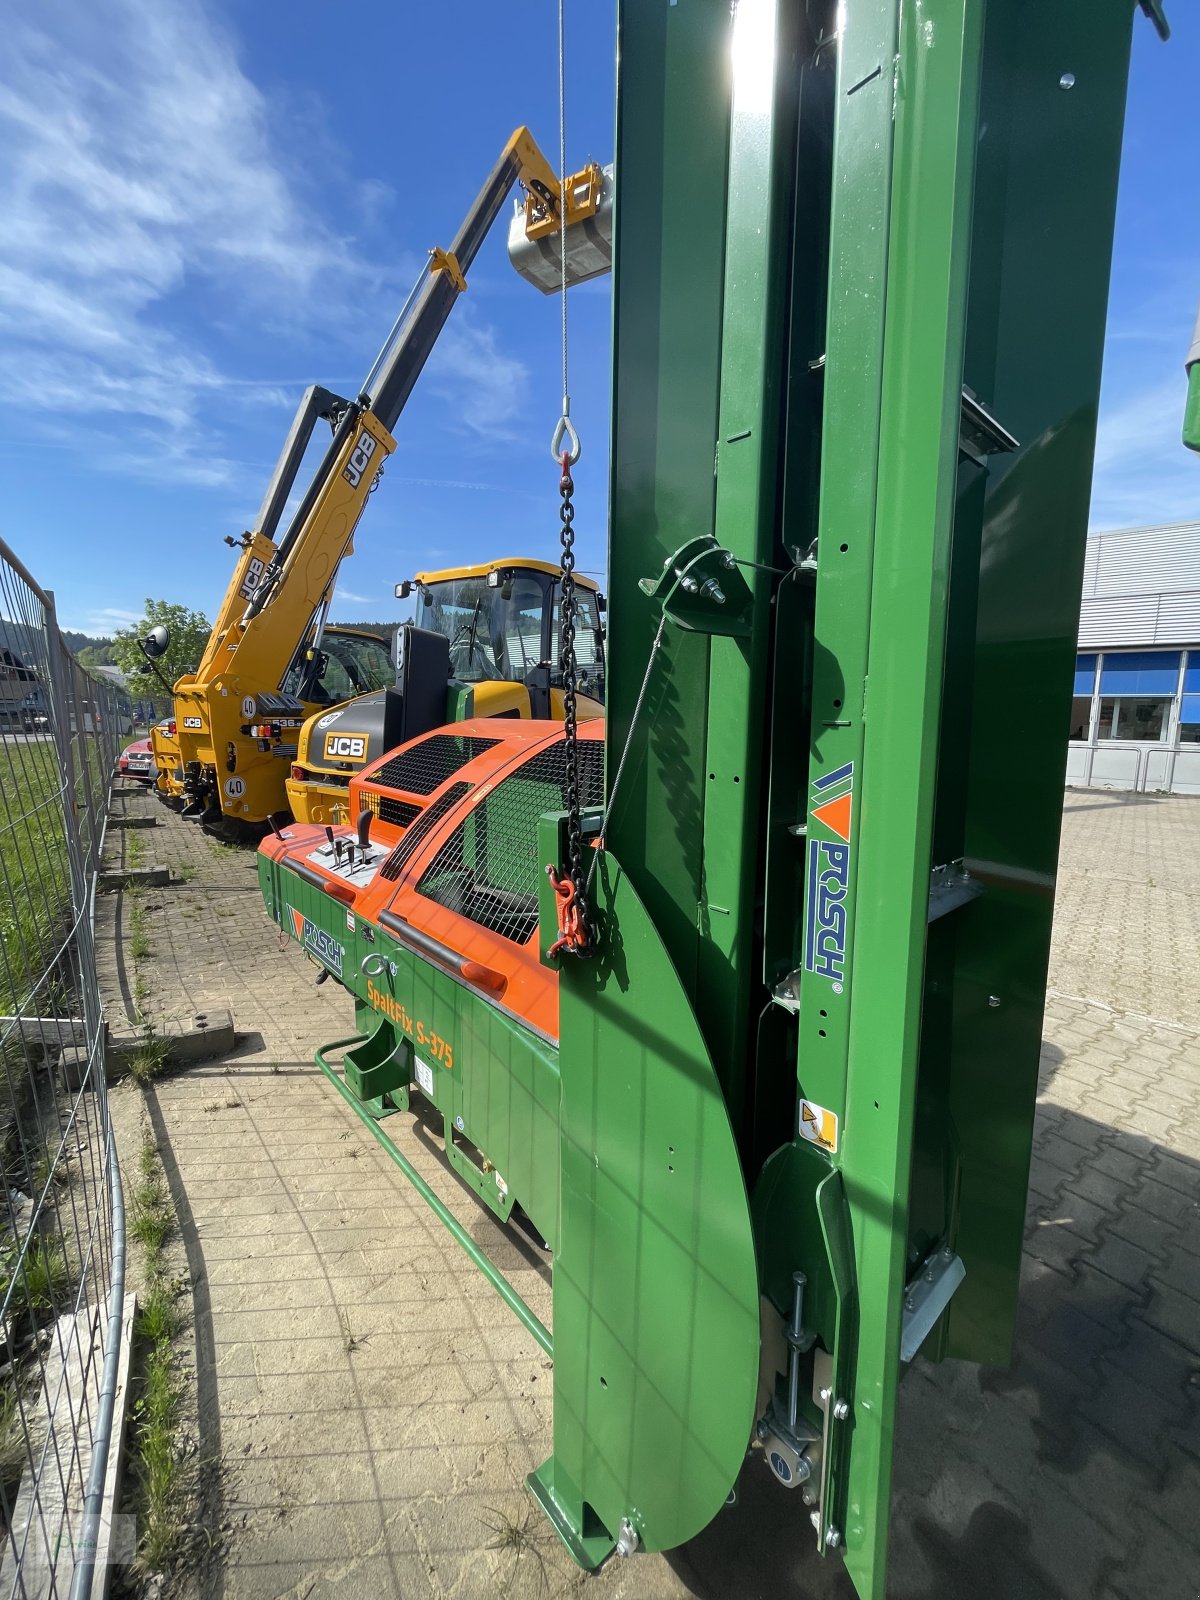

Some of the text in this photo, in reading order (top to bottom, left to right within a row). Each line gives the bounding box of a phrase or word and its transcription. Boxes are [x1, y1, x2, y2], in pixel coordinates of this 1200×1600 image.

[345, 432, 376, 487] JCB
[241, 558, 264, 601] JCB
[244, 700, 253, 714] 40
[184, 717, 202, 728] JCB
[327, 737, 364, 757] JCB
[229, 780, 242, 794] 40
[367, 979, 453, 1069] SpaltFix S-375
